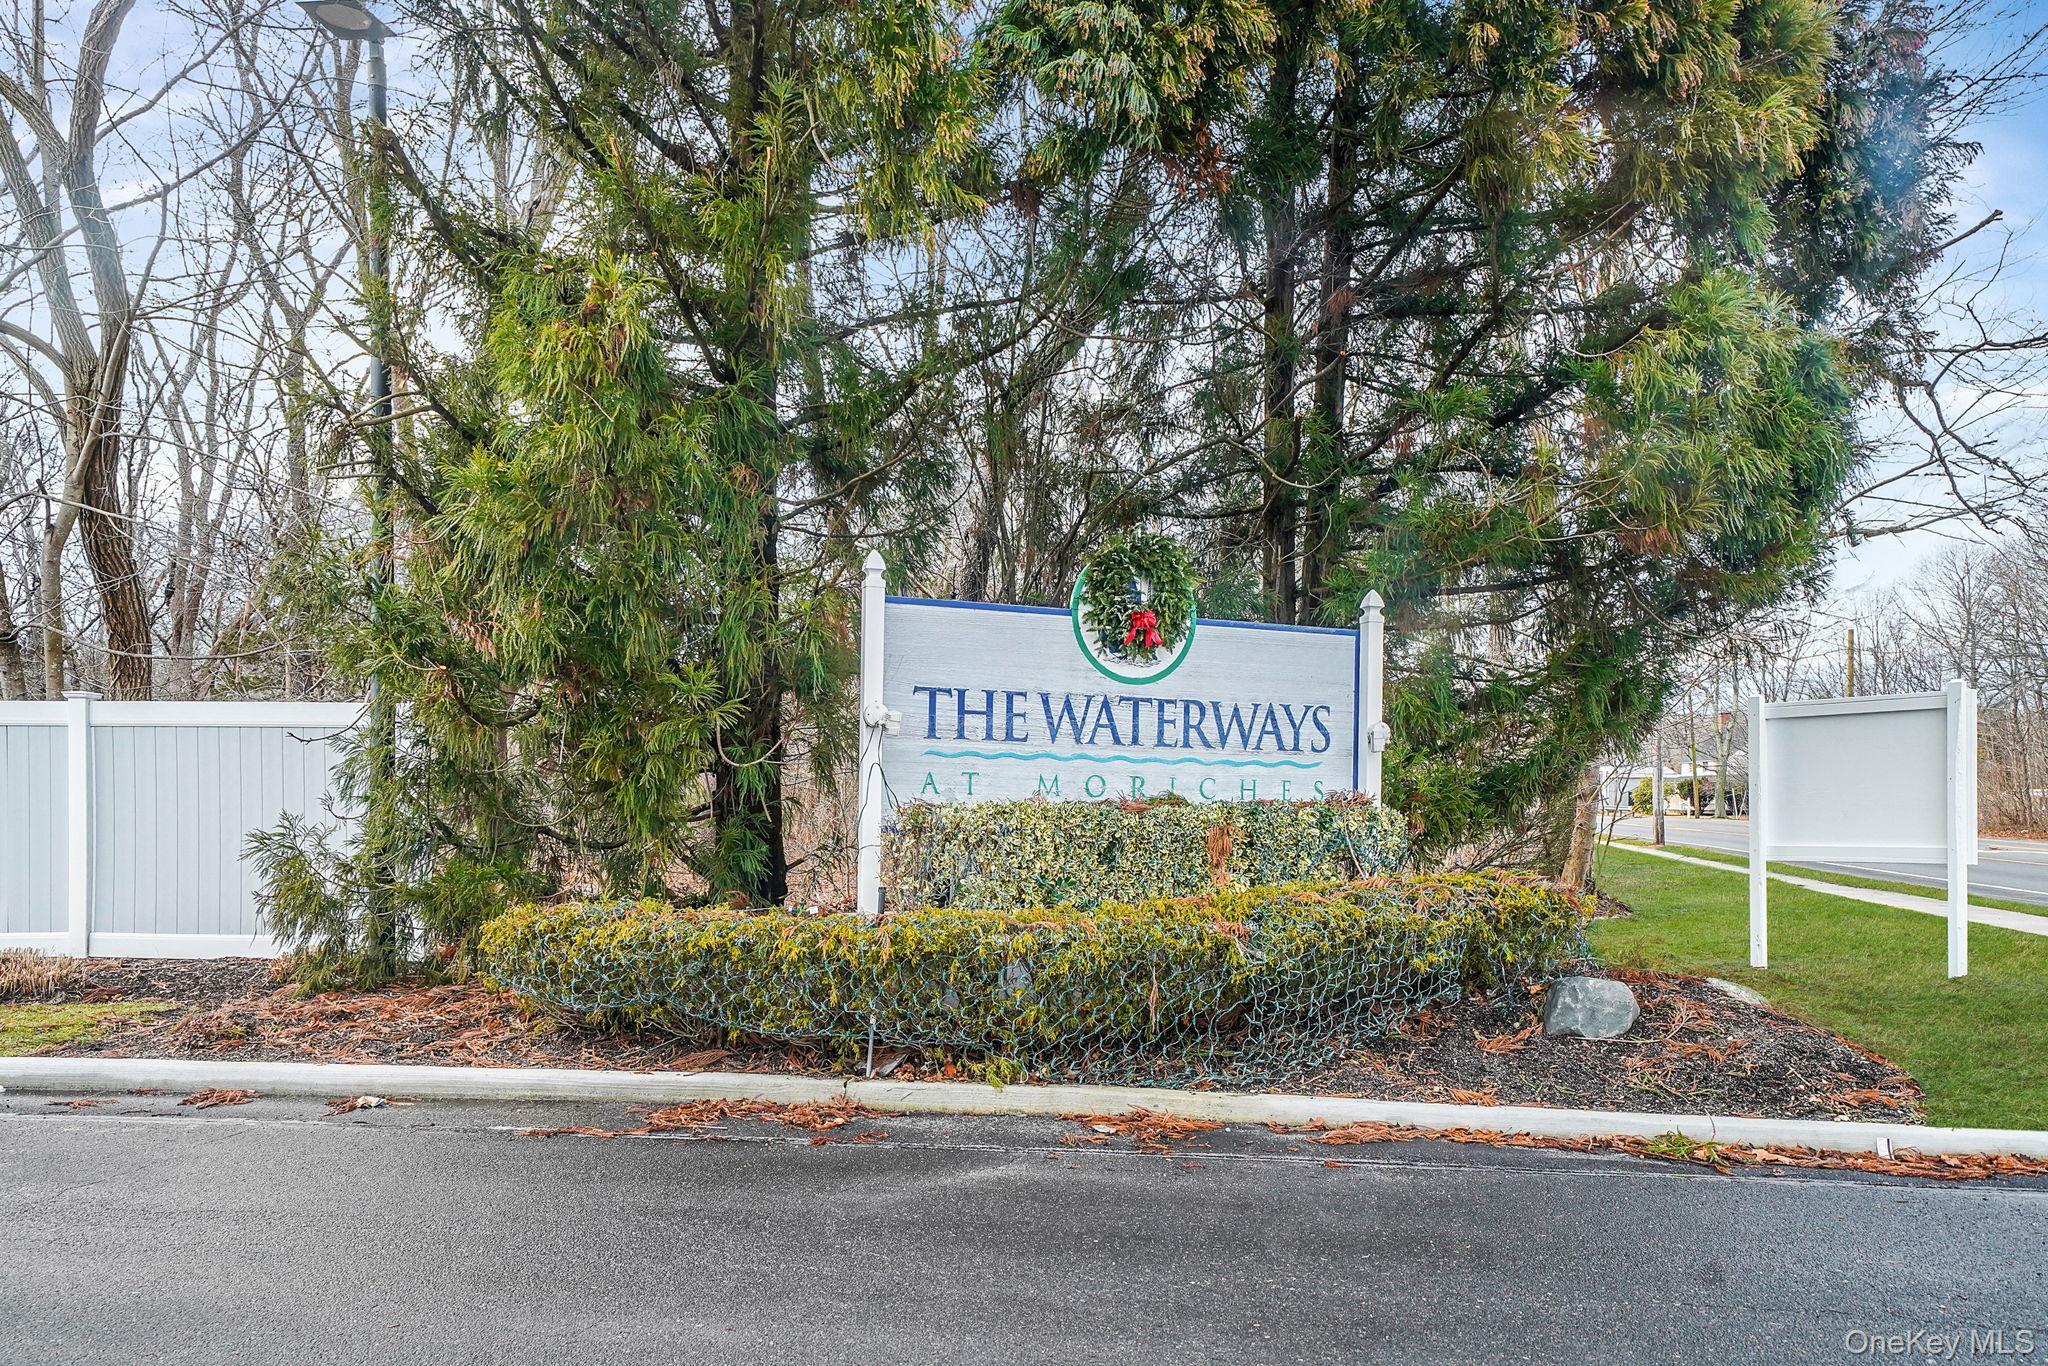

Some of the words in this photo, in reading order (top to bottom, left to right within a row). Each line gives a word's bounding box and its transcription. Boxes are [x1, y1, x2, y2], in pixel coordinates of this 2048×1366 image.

[913, 685, 1029, 743] THE
[1038, 691, 1331, 753] WATERWAYS
[920, 771, 980, 796] AT
[1037, 773, 1326, 801] MORICHES
